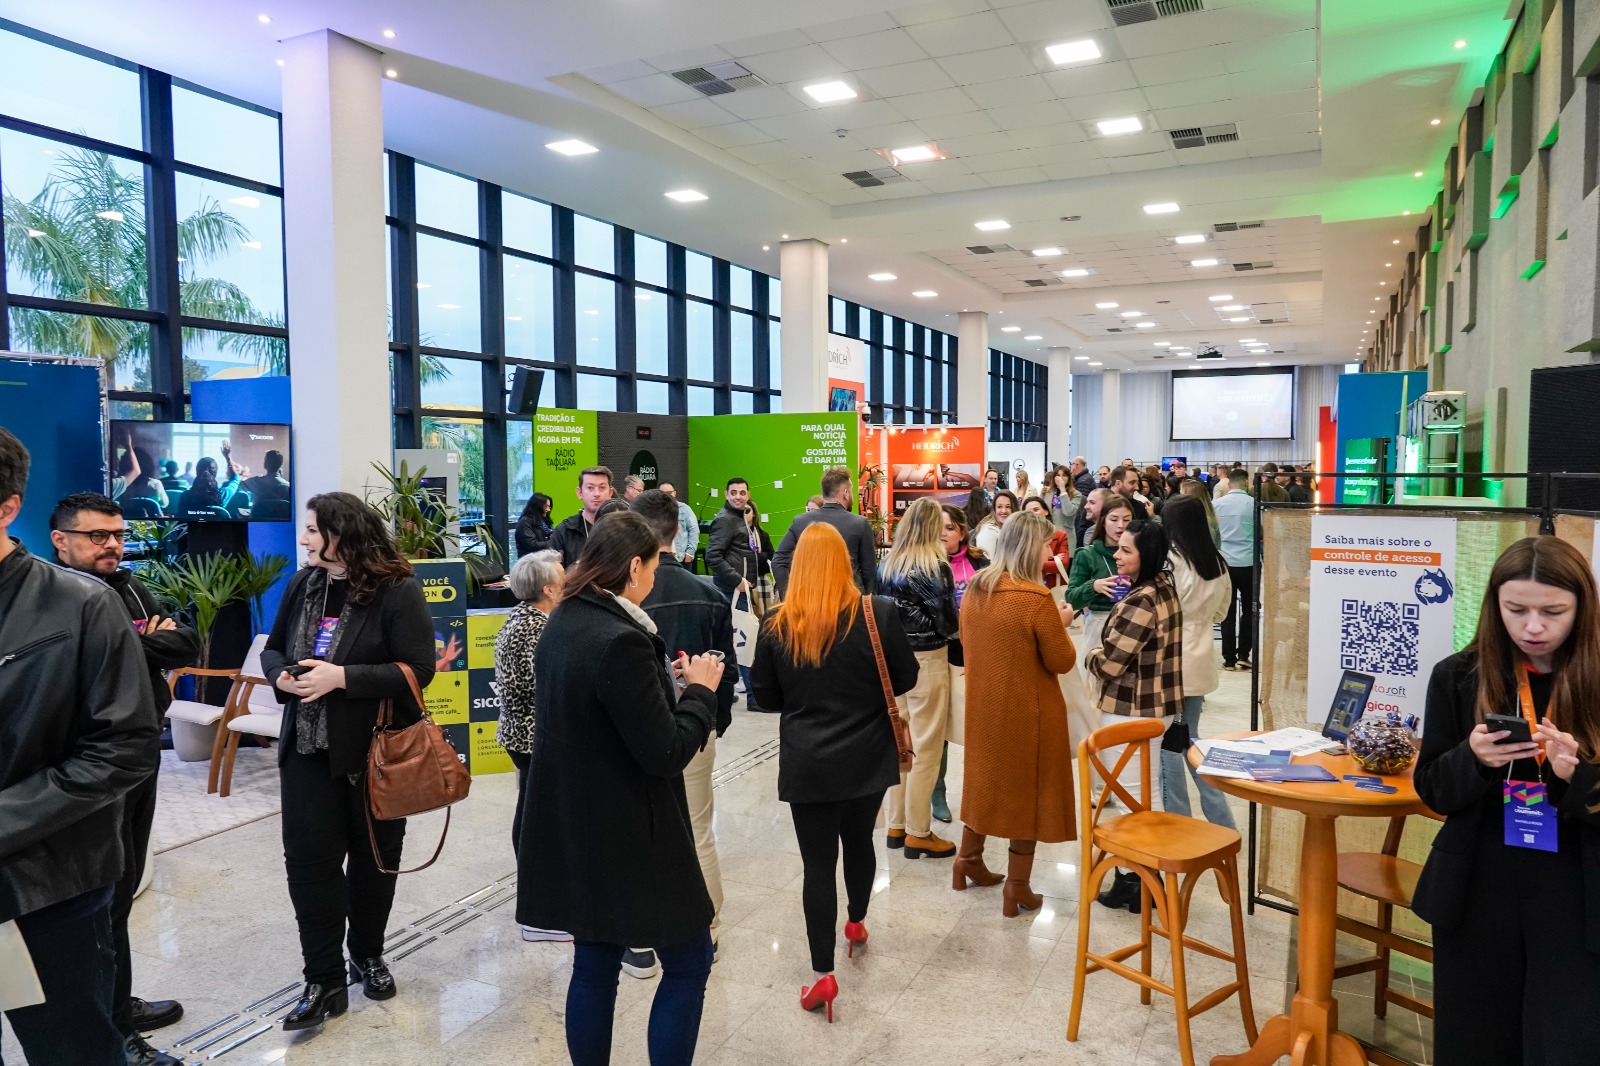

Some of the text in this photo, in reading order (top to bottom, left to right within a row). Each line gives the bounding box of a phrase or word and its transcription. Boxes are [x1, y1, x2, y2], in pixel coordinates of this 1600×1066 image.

[536, 413, 569, 423] TRADIÇÃO
[537, 425, 584, 433] CREDIBILIDADE
[813, 431, 846, 439] NOTÍCIA
[822, 439, 844, 447] VOCÊ
[555, 447, 575, 458] RÁDIO
[546, 458, 576, 470] TAQUARA
[640, 465, 655, 473] RÁDIO
[1325, 535, 1354, 545] Saiba
[1358, 537, 1384, 546] mais
[1388, 537, 1420, 547] sobre
[1324, 551, 1432, 563] controle de acesso
[1324, 565, 1397, 577] desse evento
[423, 576, 450, 586] VOCÊ
[1371, 684, 1406, 696] tasoft
[473, 697, 502, 709] SICO
[1366, 701, 1399, 712] gicon
